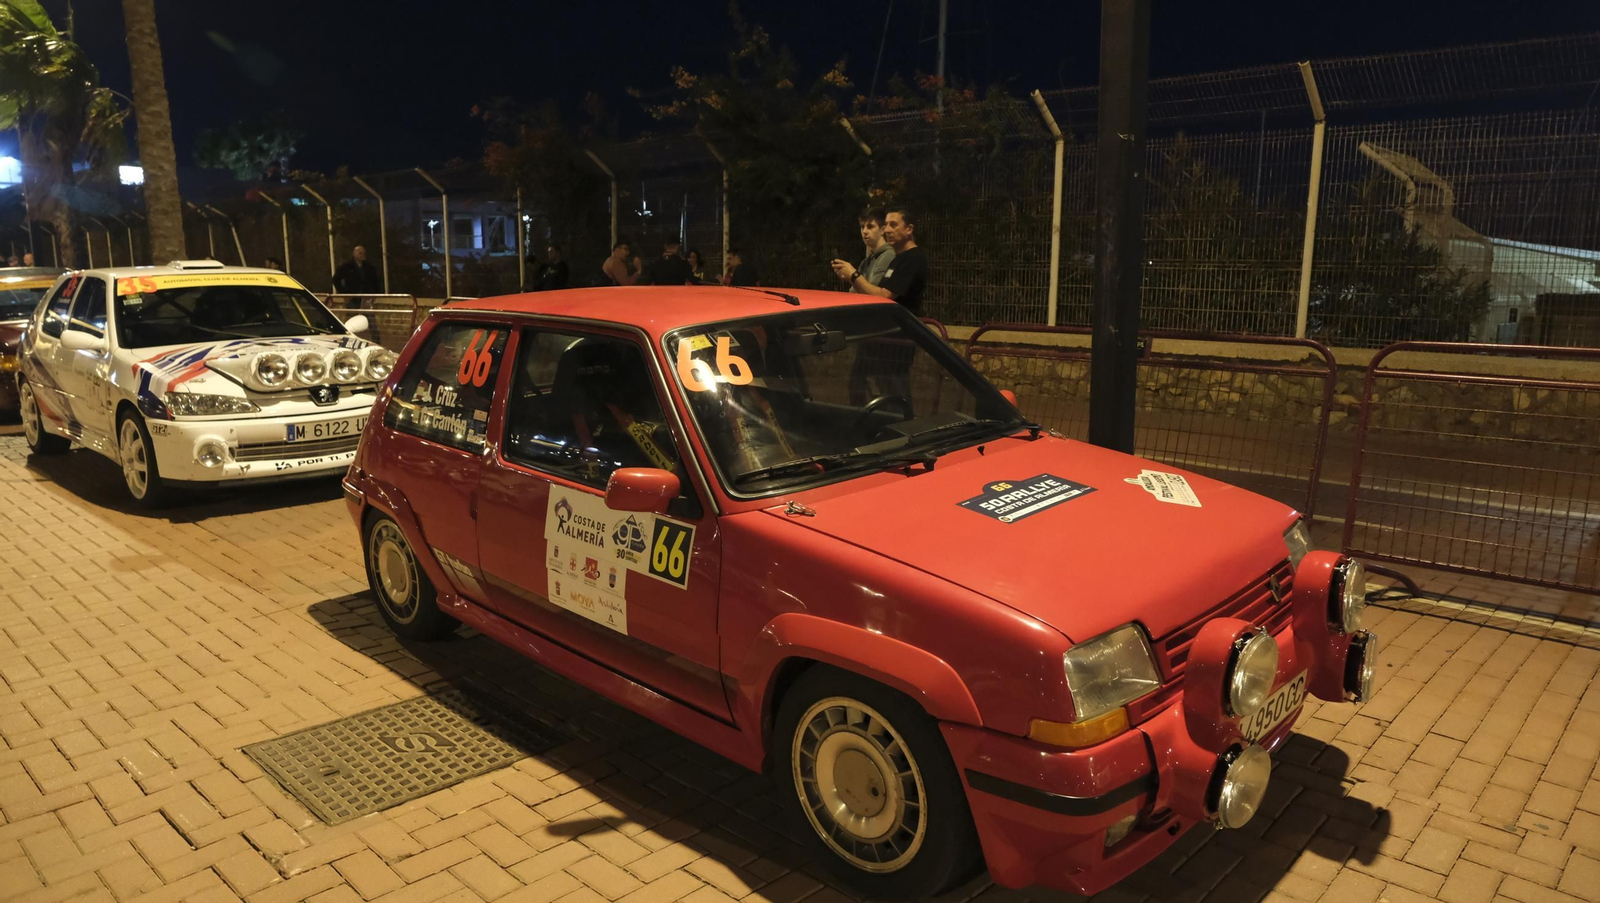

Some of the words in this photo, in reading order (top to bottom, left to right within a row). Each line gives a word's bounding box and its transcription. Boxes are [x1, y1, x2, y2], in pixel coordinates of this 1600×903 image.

[118, 275, 157, 294] 35
[457, 329, 498, 387] 66
[677, 336, 754, 392] 66
[435, 385, 458, 408] Cruz
[296, 425, 306, 439] M
[313, 420, 350, 437] 6122
[432, 409, 468, 435] Cantón
[275, 461, 293, 471] VA
[297, 458, 324, 467] POR
[990, 482, 1013, 492] 66
[573, 514, 596, 530] COSTA
[596, 521, 606, 533] DE
[565, 525, 605, 549] ALMERÍA
[616, 548, 626, 560] 30
[652, 525, 687, 578] 66
[570, 590, 595, 610] MOYA
